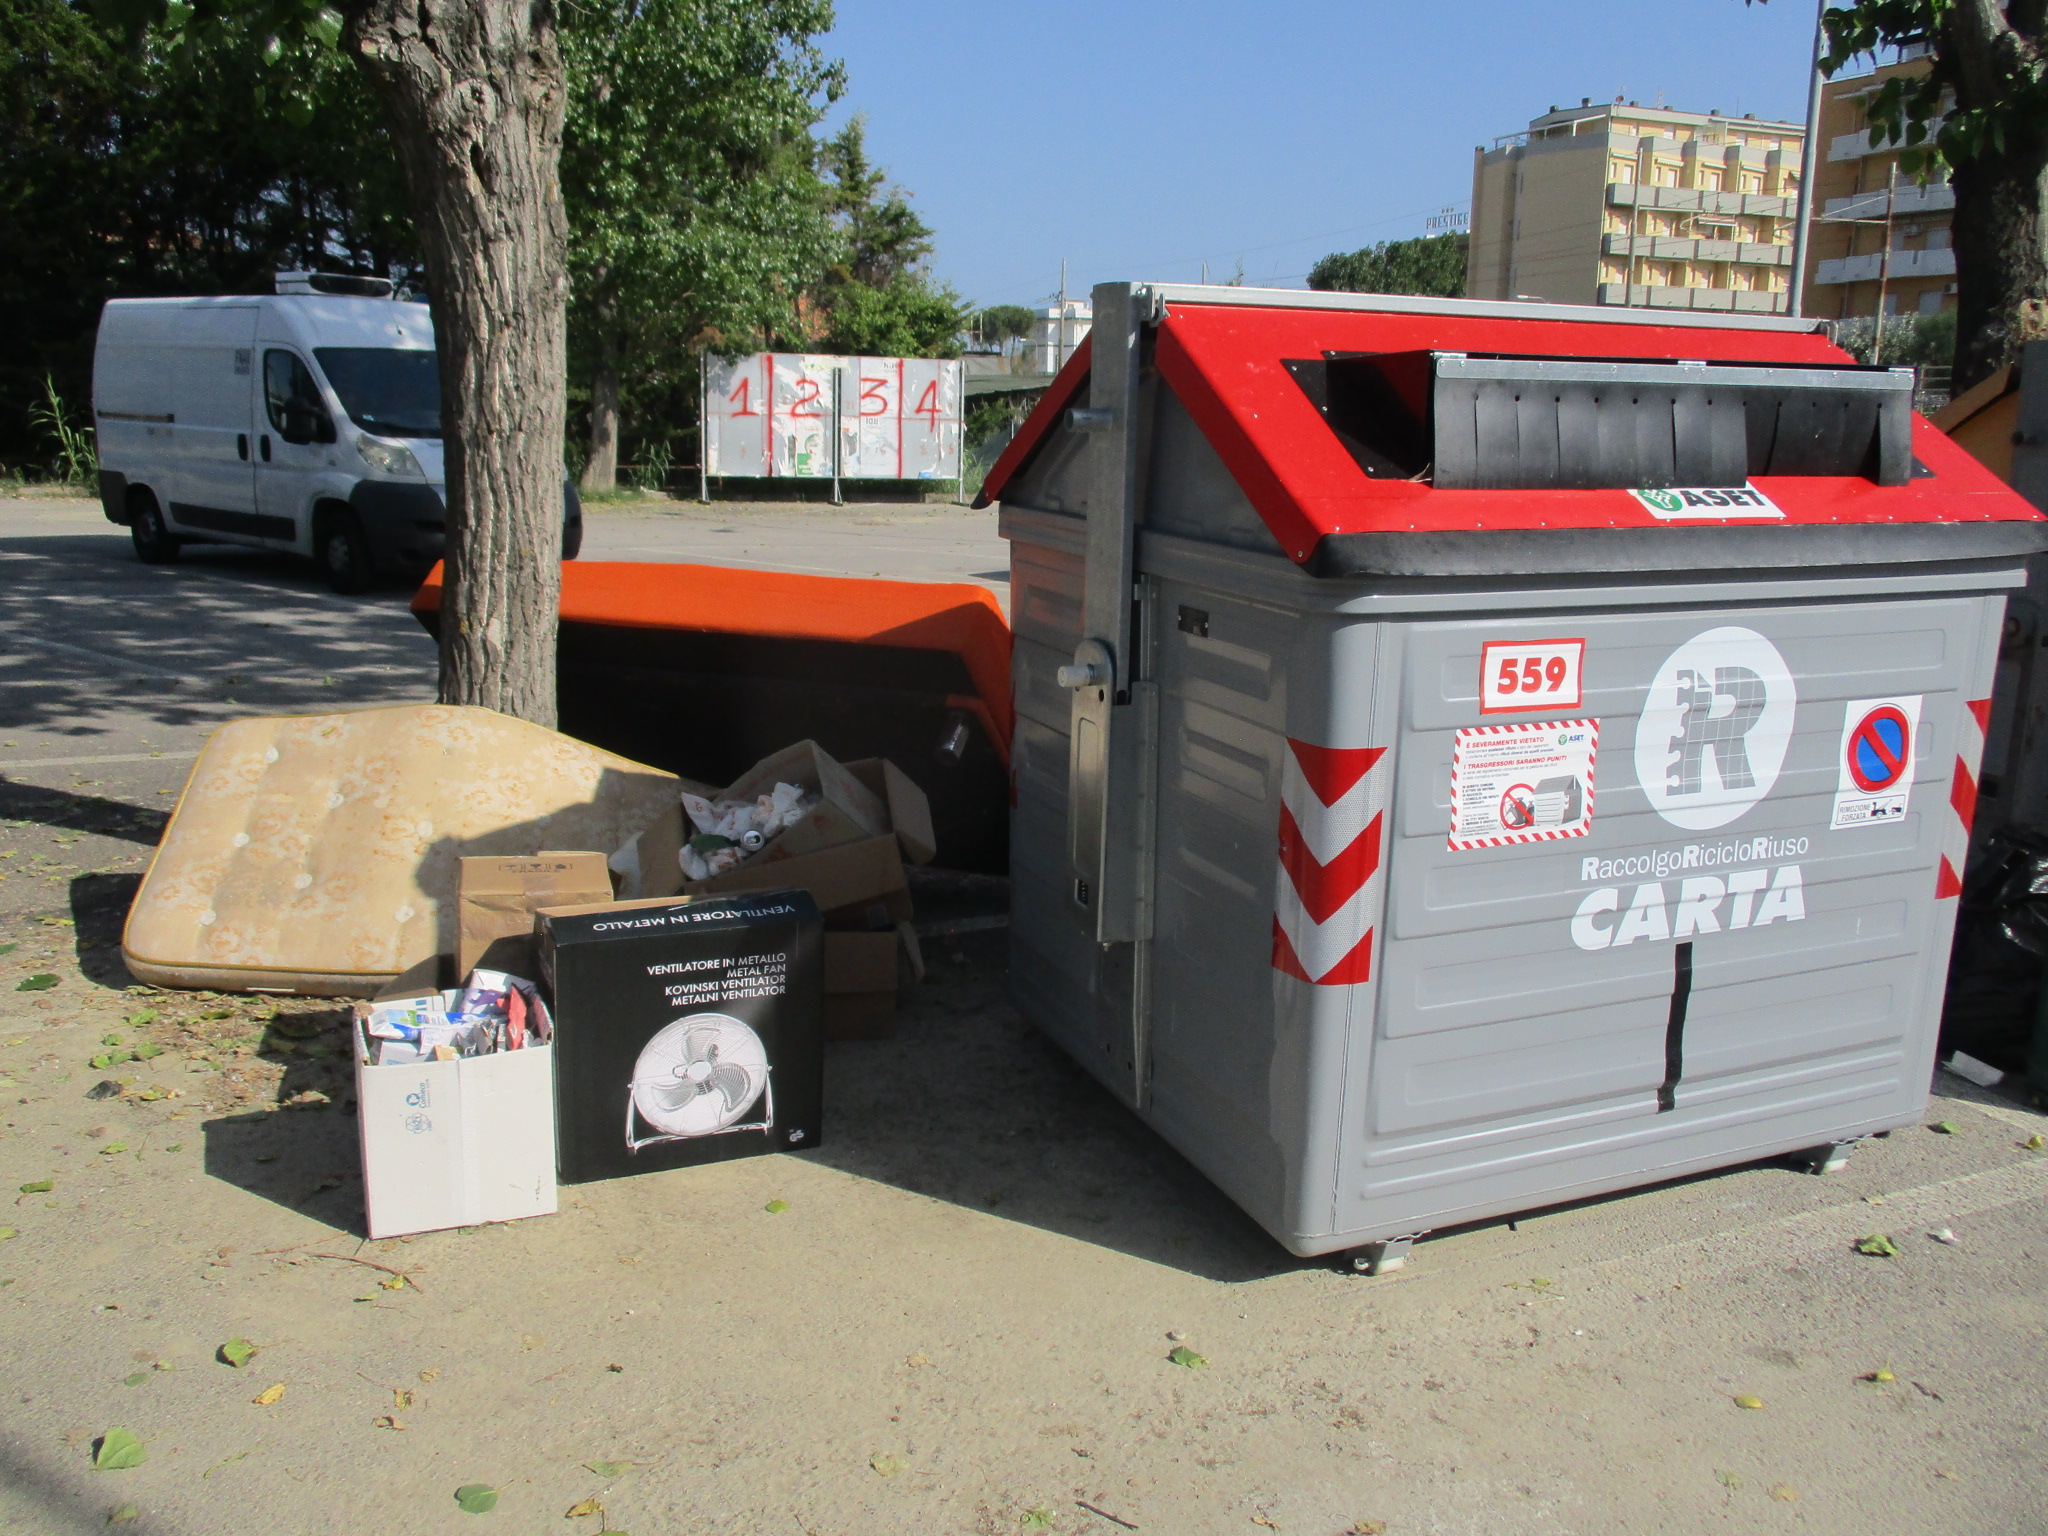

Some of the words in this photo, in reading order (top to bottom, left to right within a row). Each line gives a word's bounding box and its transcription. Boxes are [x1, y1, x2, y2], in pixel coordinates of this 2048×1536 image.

[1426, 212, 1469, 229] PRESTIGE
[729, 377, 759, 418] 1
[790, 379, 822, 418] 2
[860, 378, 888, 417] 3
[915, 380, 942, 432] 4
[1679, 490, 1766, 507] ASET
[1497, 656, 1567, 695] 559
[1472, 738, 1518, 748] SEVERAMENTE
[1519, 736, 1545, 744] VIETATO
[1569, 734, 1584, 742] ASET
[1468, 760, 1515, 770] TRASGRESSORI
[1516, 757, 1546, 766] SARANNO
[1547, 755, 1568, 763] PUNITI
[1840, 803, 1871, 813] RIMOZIONE
[1842, 813, 1866, 821] FORZATA
[693, 904, 796, 923] VENTILATORE
[1570, 864, 1806, 951] CARTA
[592, 915, 666, 931] METALLO
[670, 914, 689, 924] IN
[647, 959, 721, 976] VENTILATORE
[722, 956, 736, 969] IN
[738, 952, 786, 967] METALLO
[726, 966, 761, 978] METAL
[763, 963, 786, 975] FAN
[665, 981, 719, 996] KOVINSKI
[721, 974, 786, 990] VENTILATOR
[671, 991, 719, 1006] METALNI
[721, 985, 786, 1001] VENTILATOR
